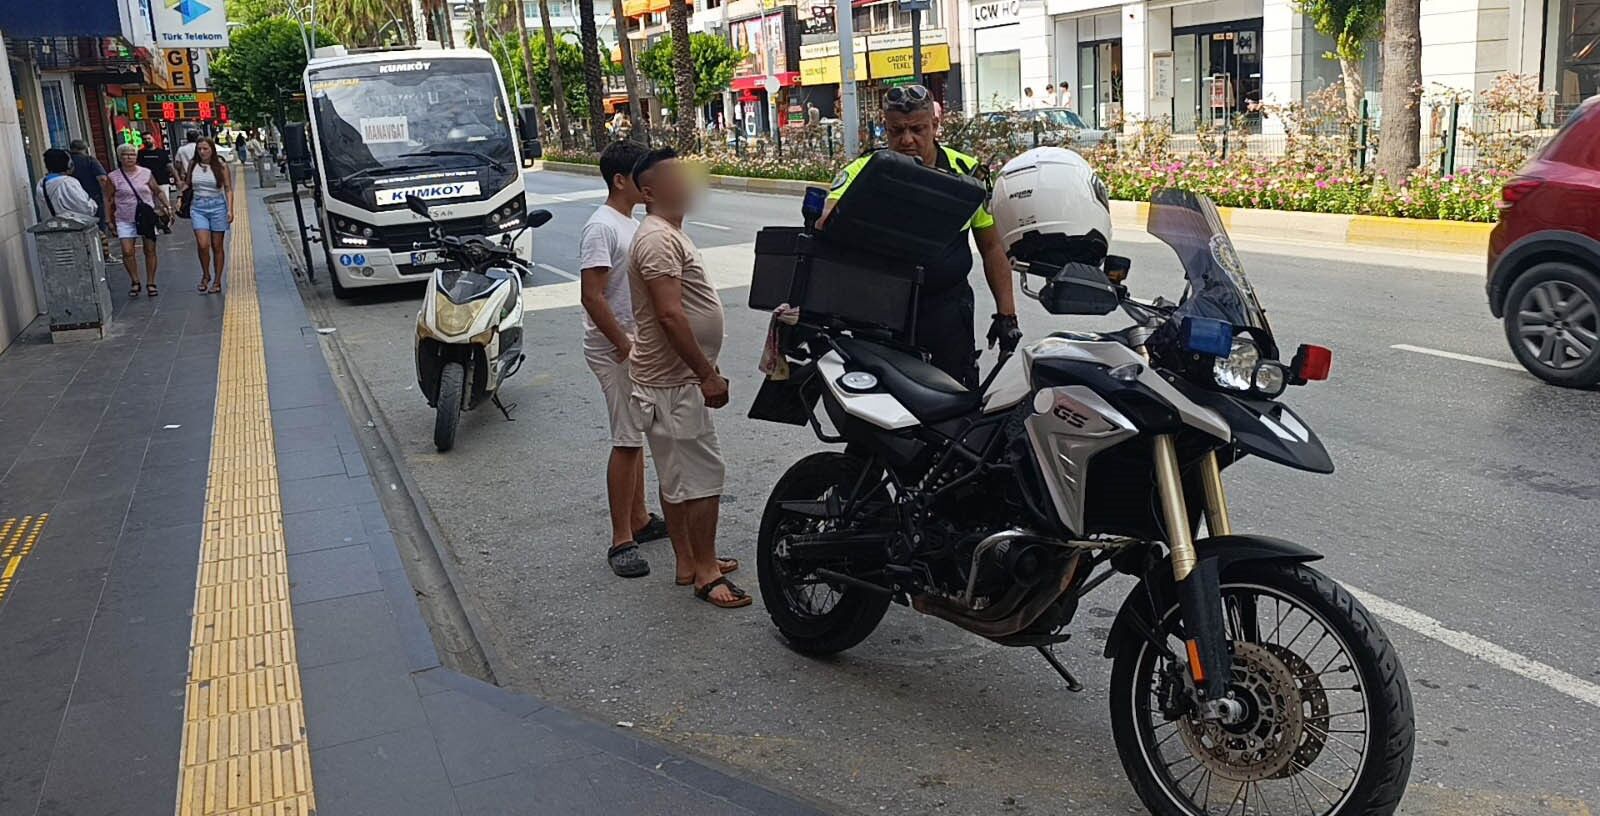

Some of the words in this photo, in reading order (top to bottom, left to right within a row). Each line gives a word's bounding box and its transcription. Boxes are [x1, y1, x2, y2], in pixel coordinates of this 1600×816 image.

[975, 4, 998, 20] LCW
[379, 62, 432, 73] KUMKÖY
[365, 124, 405, 140] MANAVGAT
[411, 210, 454, 220] KSAN
[1053, 405, 1089, 428] GS
